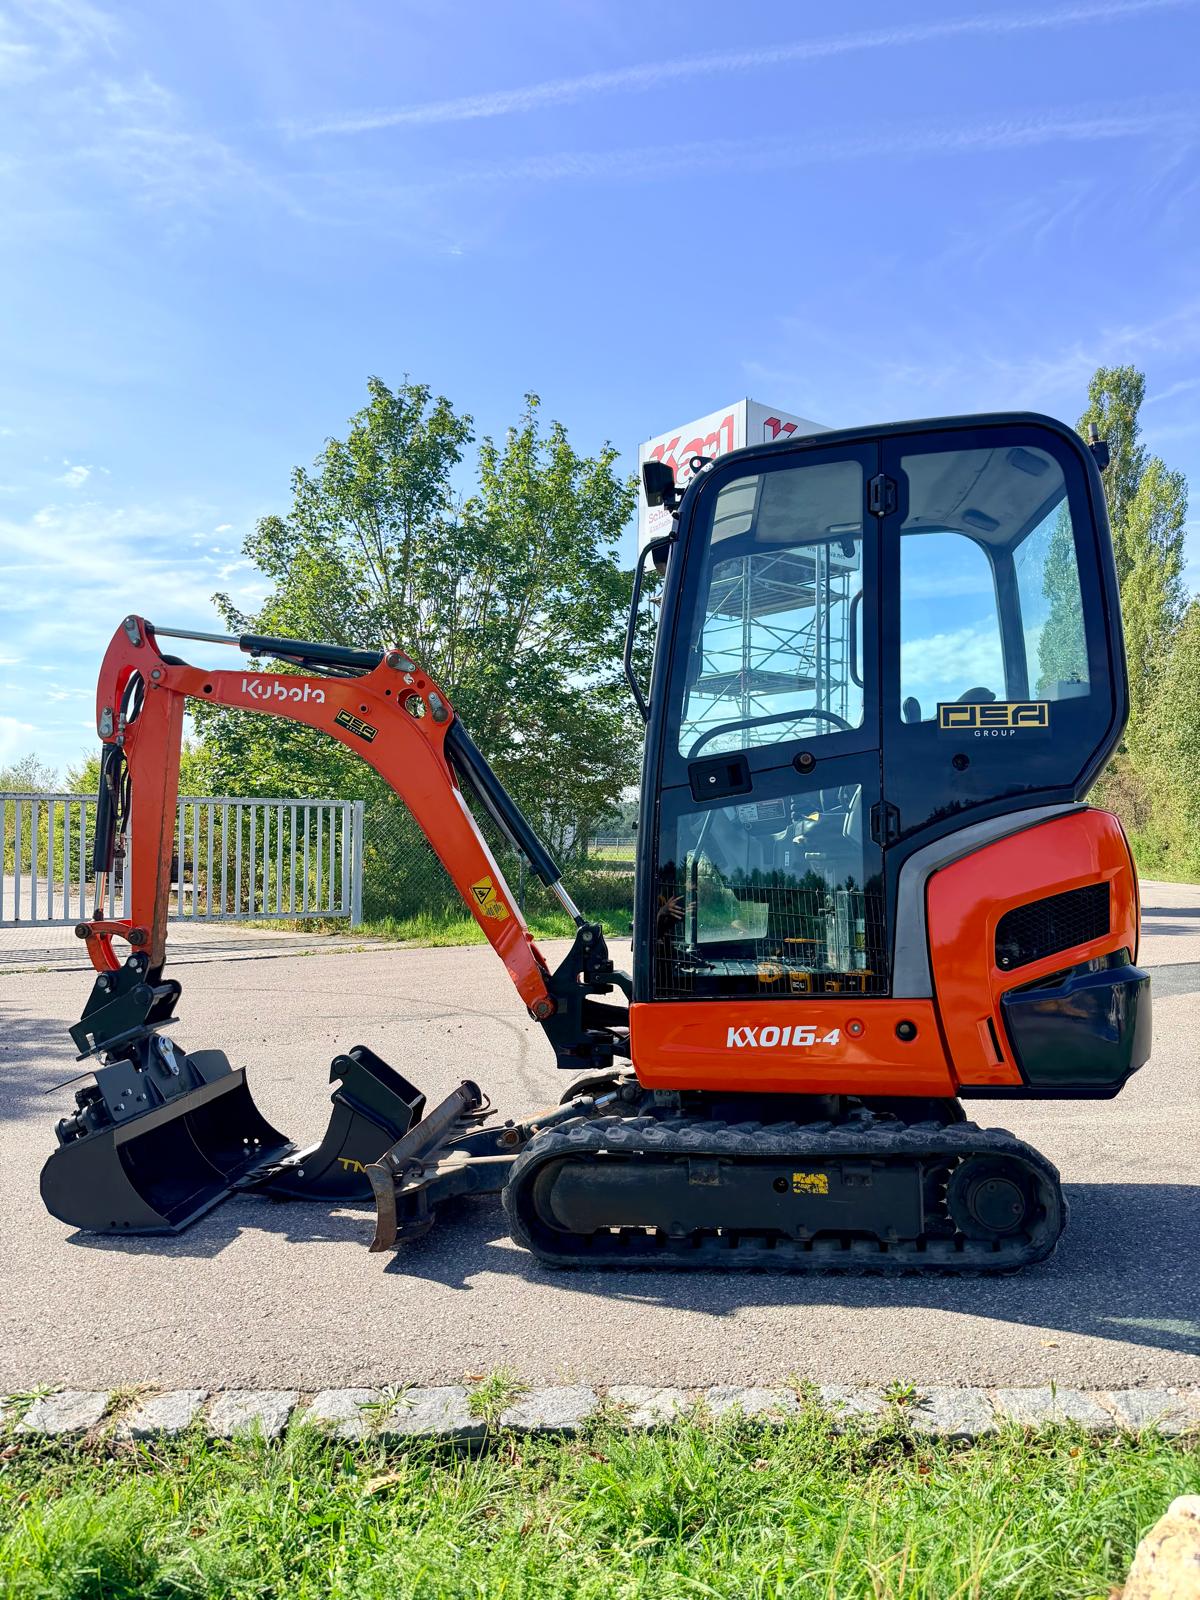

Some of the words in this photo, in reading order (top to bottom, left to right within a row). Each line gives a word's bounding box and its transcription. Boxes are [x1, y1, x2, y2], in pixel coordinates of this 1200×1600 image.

[241, 678, 326, 704] Kubota
[974, 729, 1016, 737] GROUP
[726, 1025, 840, 1048] KX016-4
